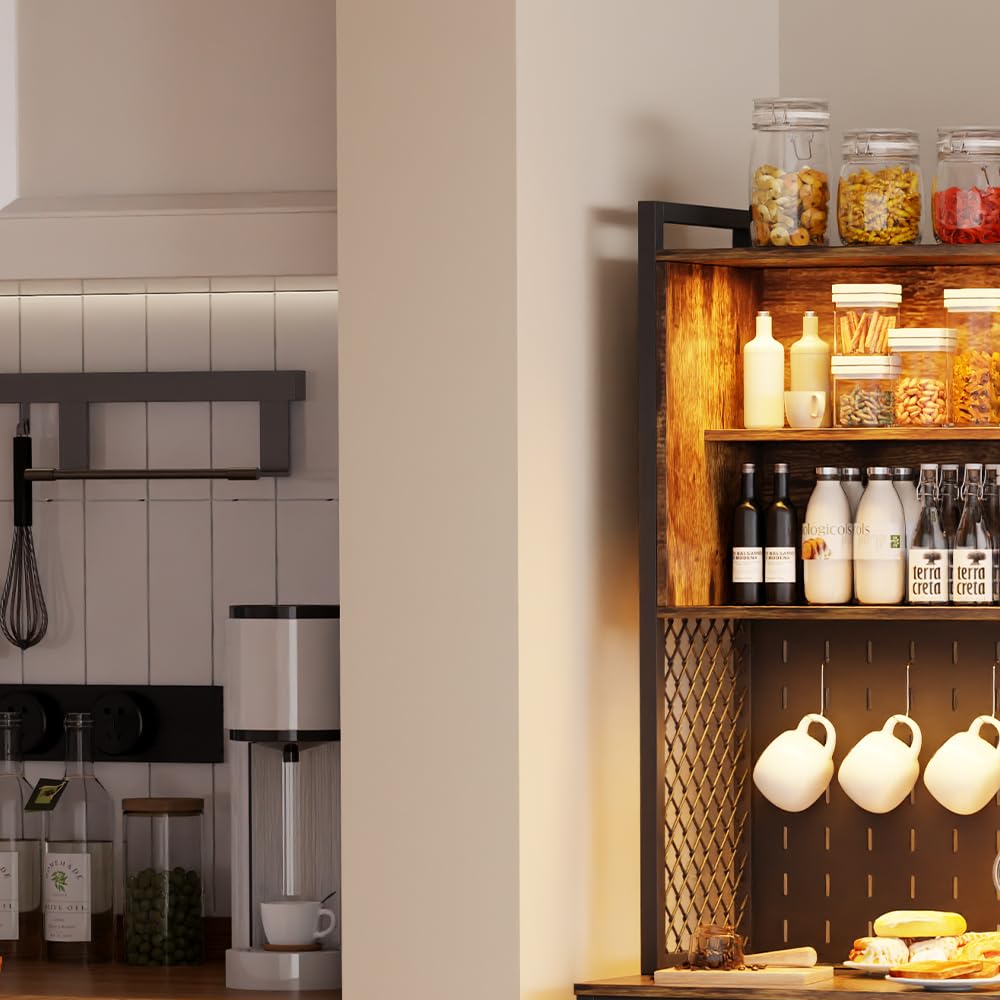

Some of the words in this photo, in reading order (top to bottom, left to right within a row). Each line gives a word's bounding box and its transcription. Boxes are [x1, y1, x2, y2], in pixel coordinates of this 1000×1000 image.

[913, 566, 941, 580] terra
[957, 566, 986, 580] terra
[912, 581, 941, 595] creta
[956, 581, 986, 595] creta
